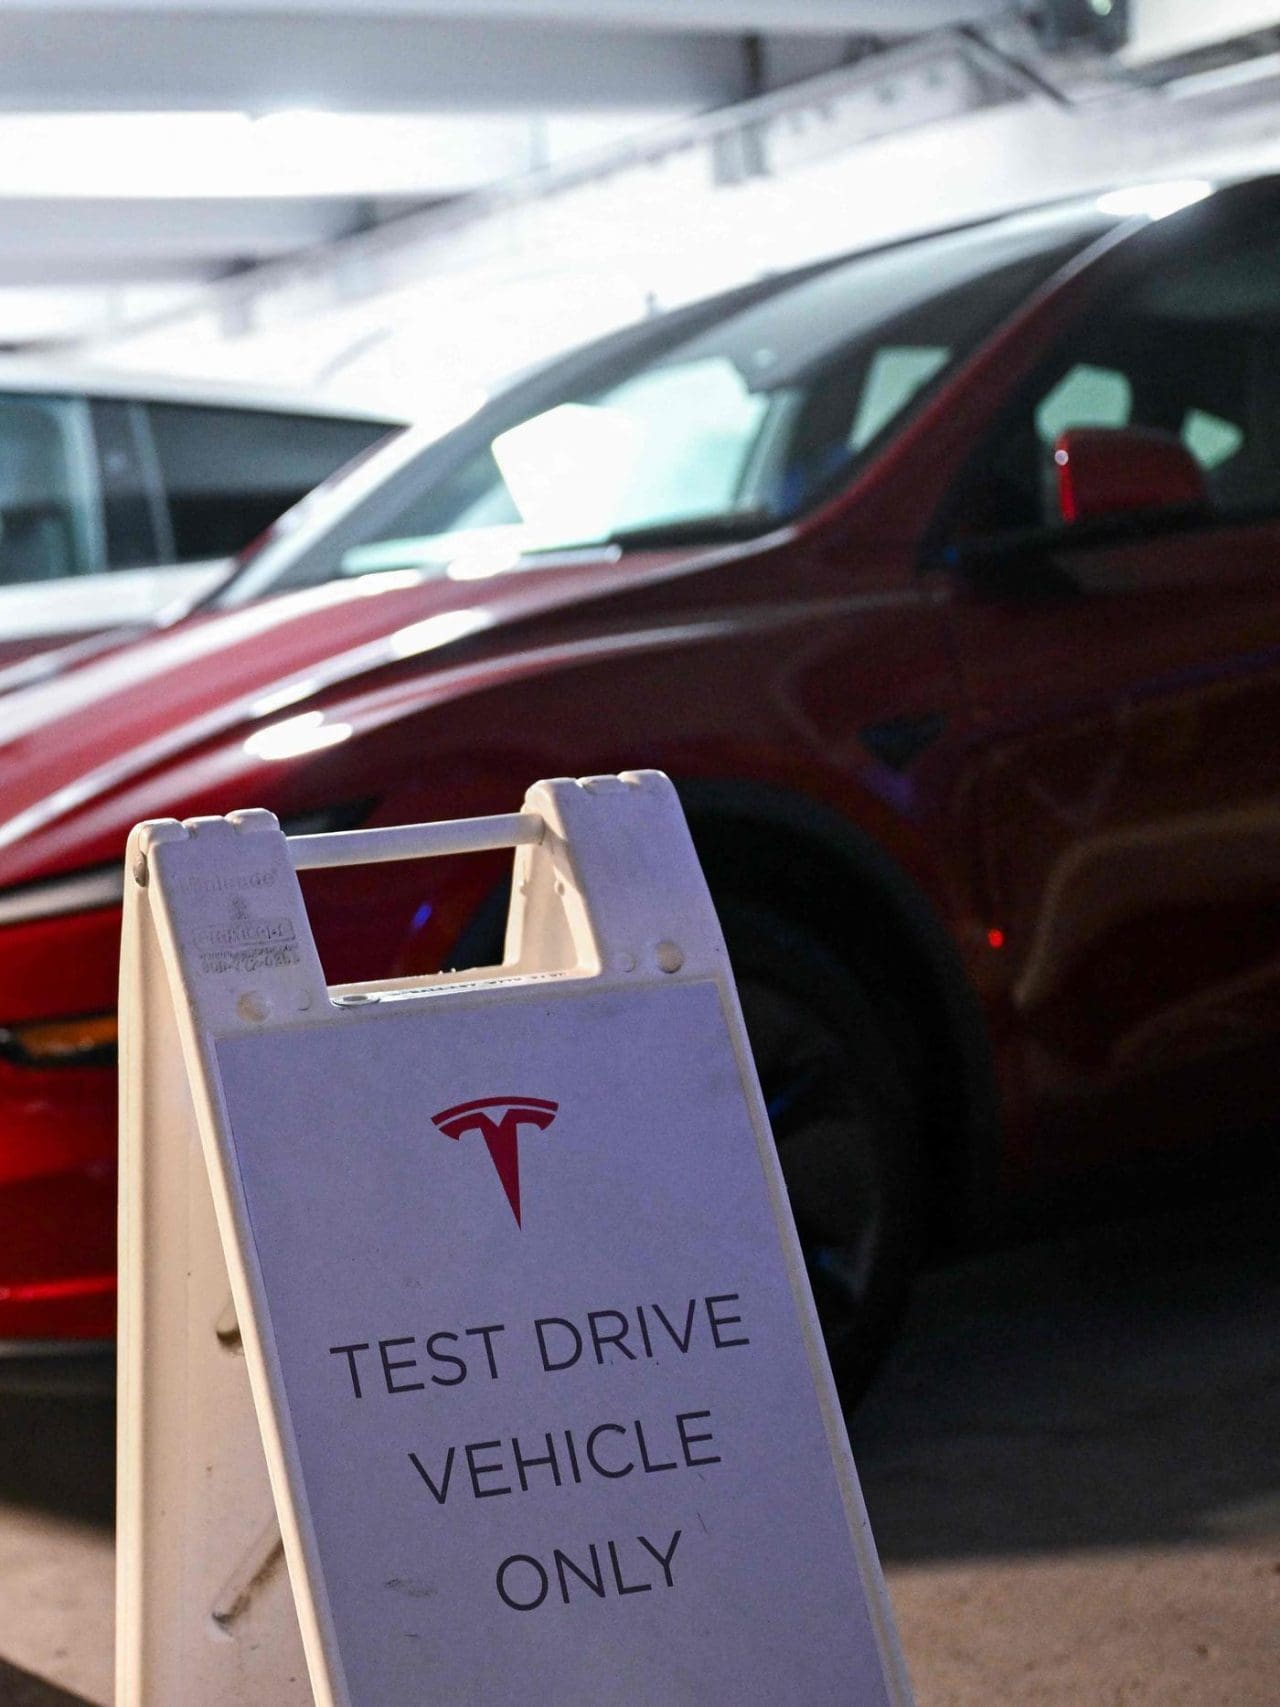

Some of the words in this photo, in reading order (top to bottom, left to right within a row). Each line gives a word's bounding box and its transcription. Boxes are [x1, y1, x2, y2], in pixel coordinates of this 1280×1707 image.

[329, 1324, 505, 1399] TEST
[534, 1293, 750, 1372] DRIVE
[407, 1409, 722, 1505] VEHICLE
[495, 1529, 682, 1612] ONLY
